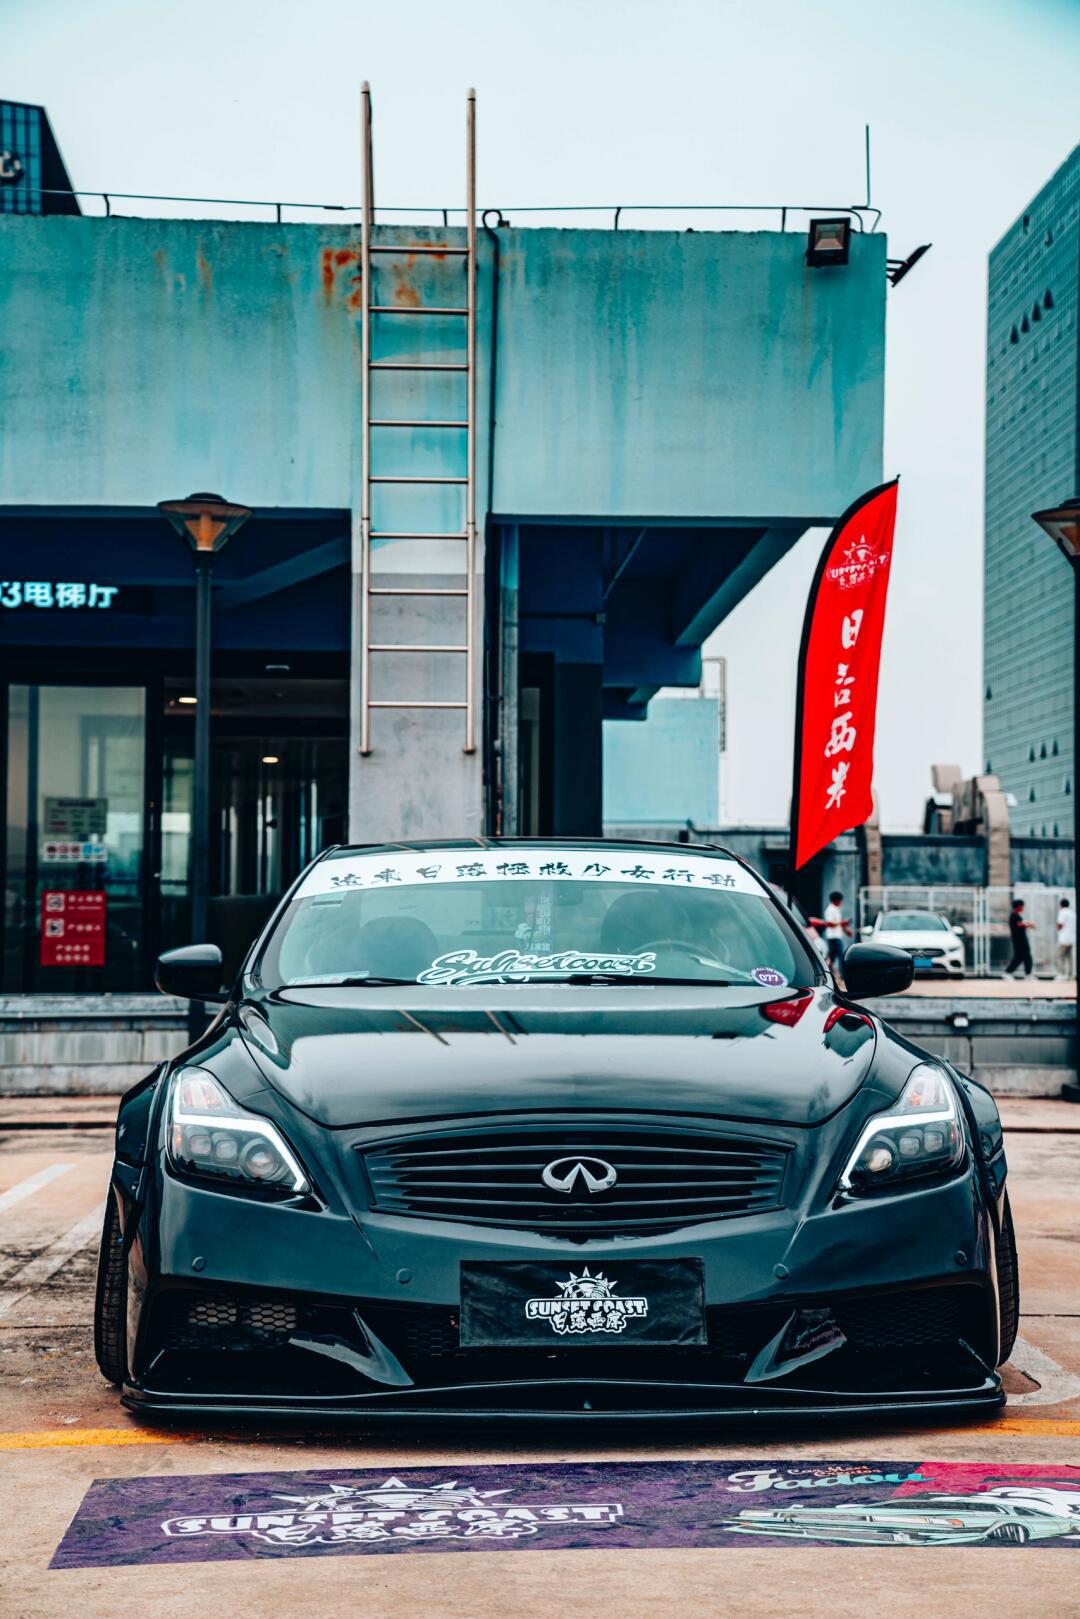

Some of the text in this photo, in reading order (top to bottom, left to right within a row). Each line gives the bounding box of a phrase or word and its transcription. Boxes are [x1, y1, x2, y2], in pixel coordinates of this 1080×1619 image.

[0, 582, 119, 608] 3电梯厅
[759, 974, 779, 982] 077
[529, 1300, 645, 1315] SUNSET COAST
[177, 1506, 610, 1533] SUNSET COAST
